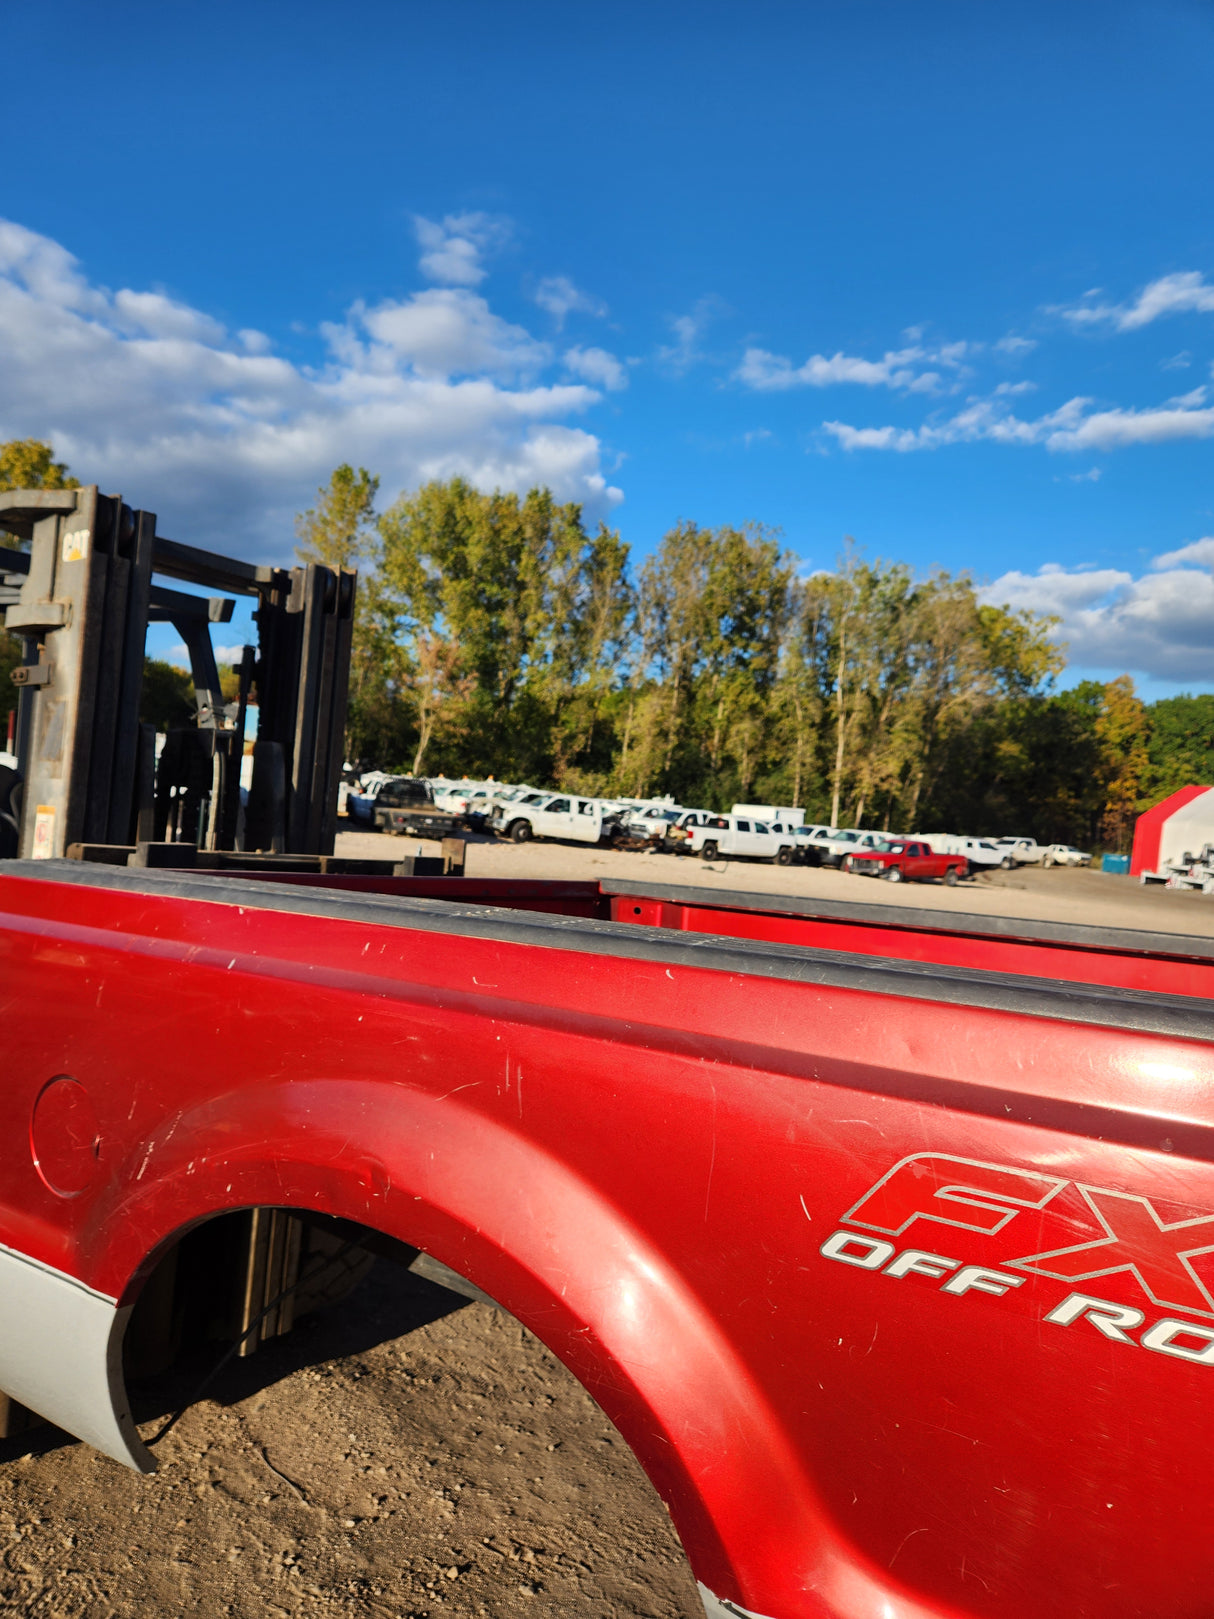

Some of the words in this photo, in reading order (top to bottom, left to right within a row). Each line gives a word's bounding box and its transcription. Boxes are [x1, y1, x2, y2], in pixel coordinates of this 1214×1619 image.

[62, 530, 90, 562] CAT
[819, 1230, 1027, 1297] OFF
[1043, 1292, 1214, 1367] RO
